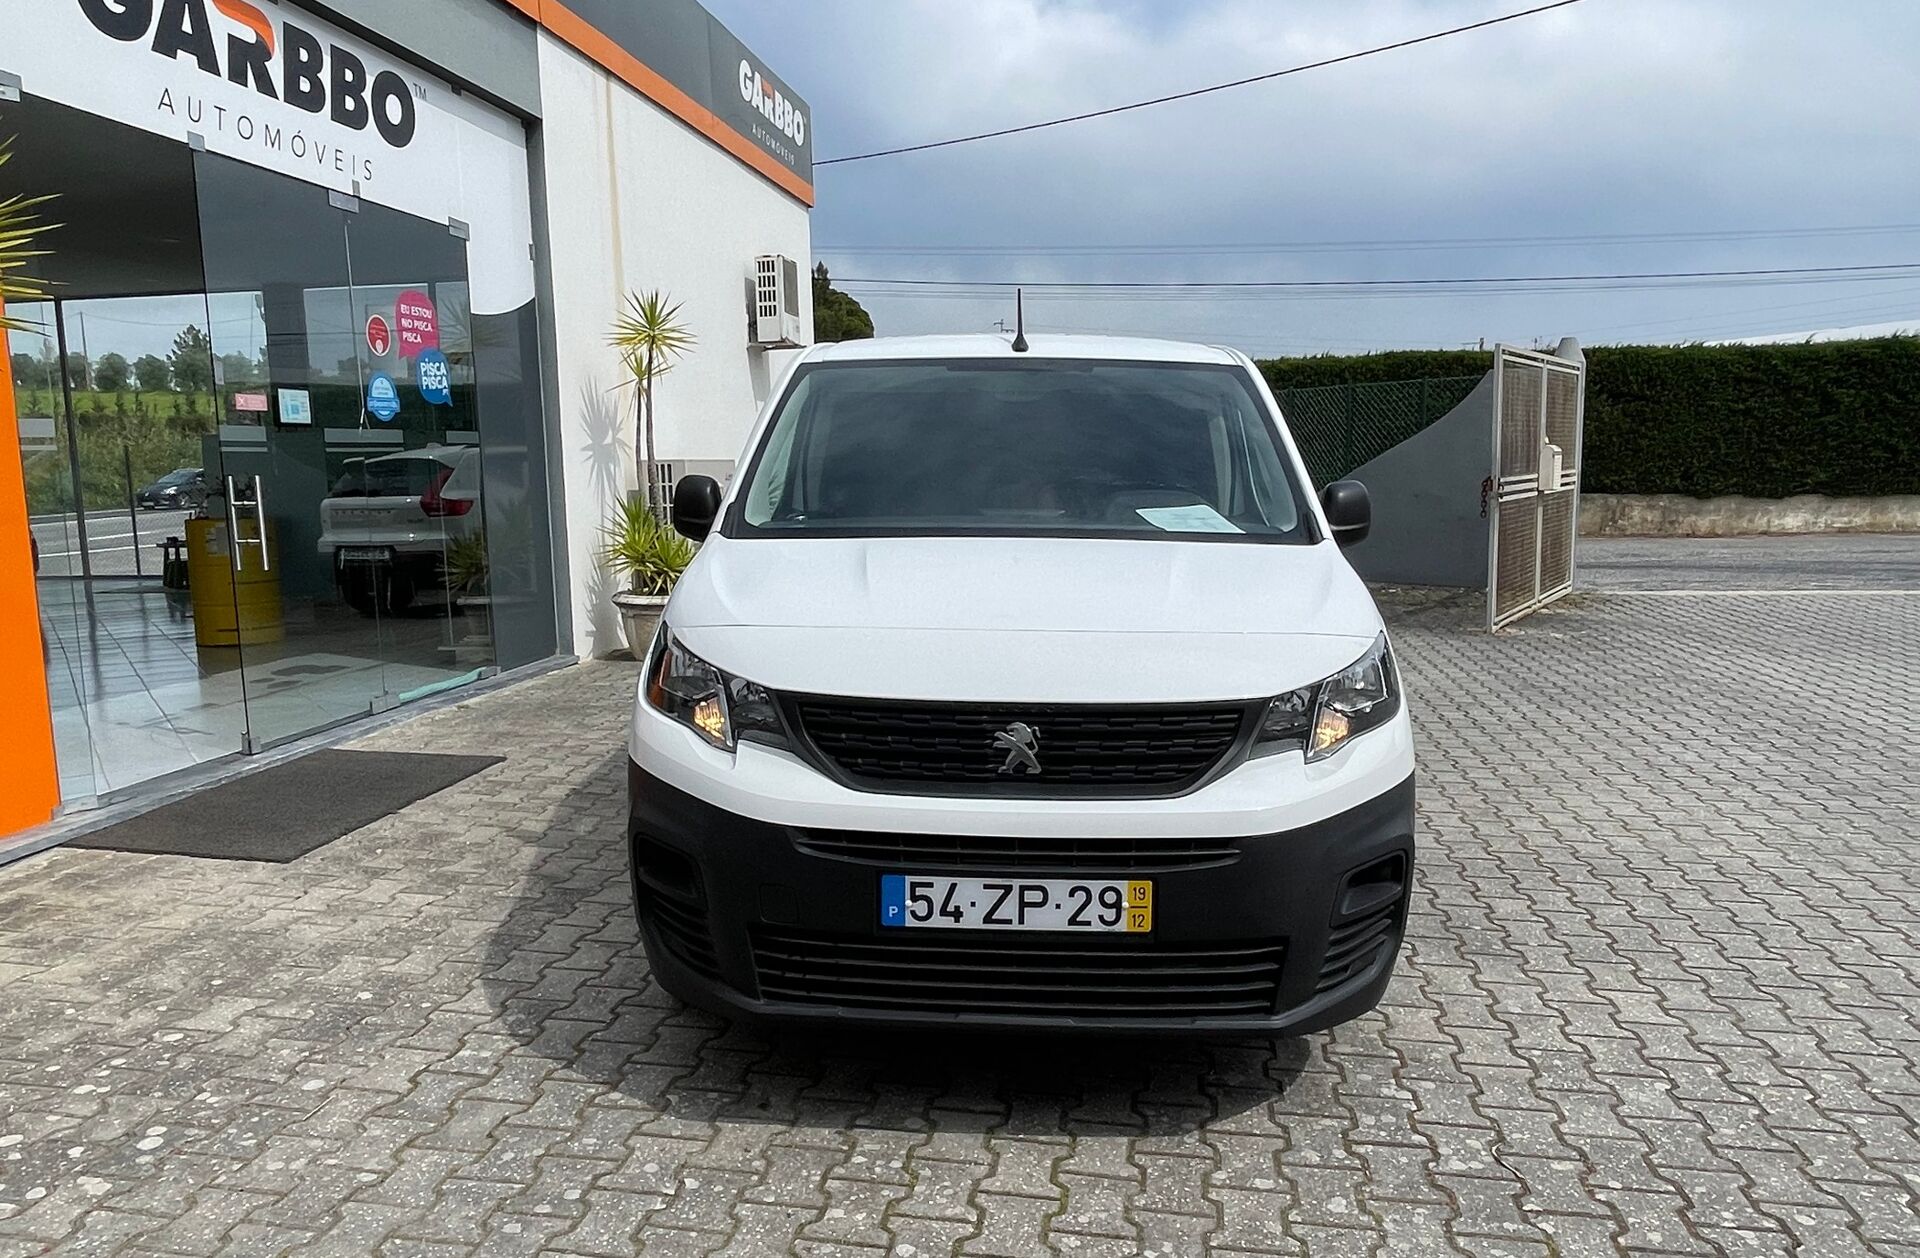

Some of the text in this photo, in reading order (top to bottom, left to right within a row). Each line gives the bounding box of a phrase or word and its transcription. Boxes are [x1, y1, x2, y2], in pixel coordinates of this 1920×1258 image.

[739, 59, 805, 146] GARBBO
[158, 88, 372, 181] AUTOMÓVEIS
[400, 304, 433, 319] EU ESTOU
[401, 318, 433, 332] NO PISCA
[402, 331, 422, 344] PISCA
[422, 376, 449, 390] PISCA
[1132, 886, 1146, 901] 19
[889, 905, 898, 917] P
[1131, 914, 1145, 928] 12
